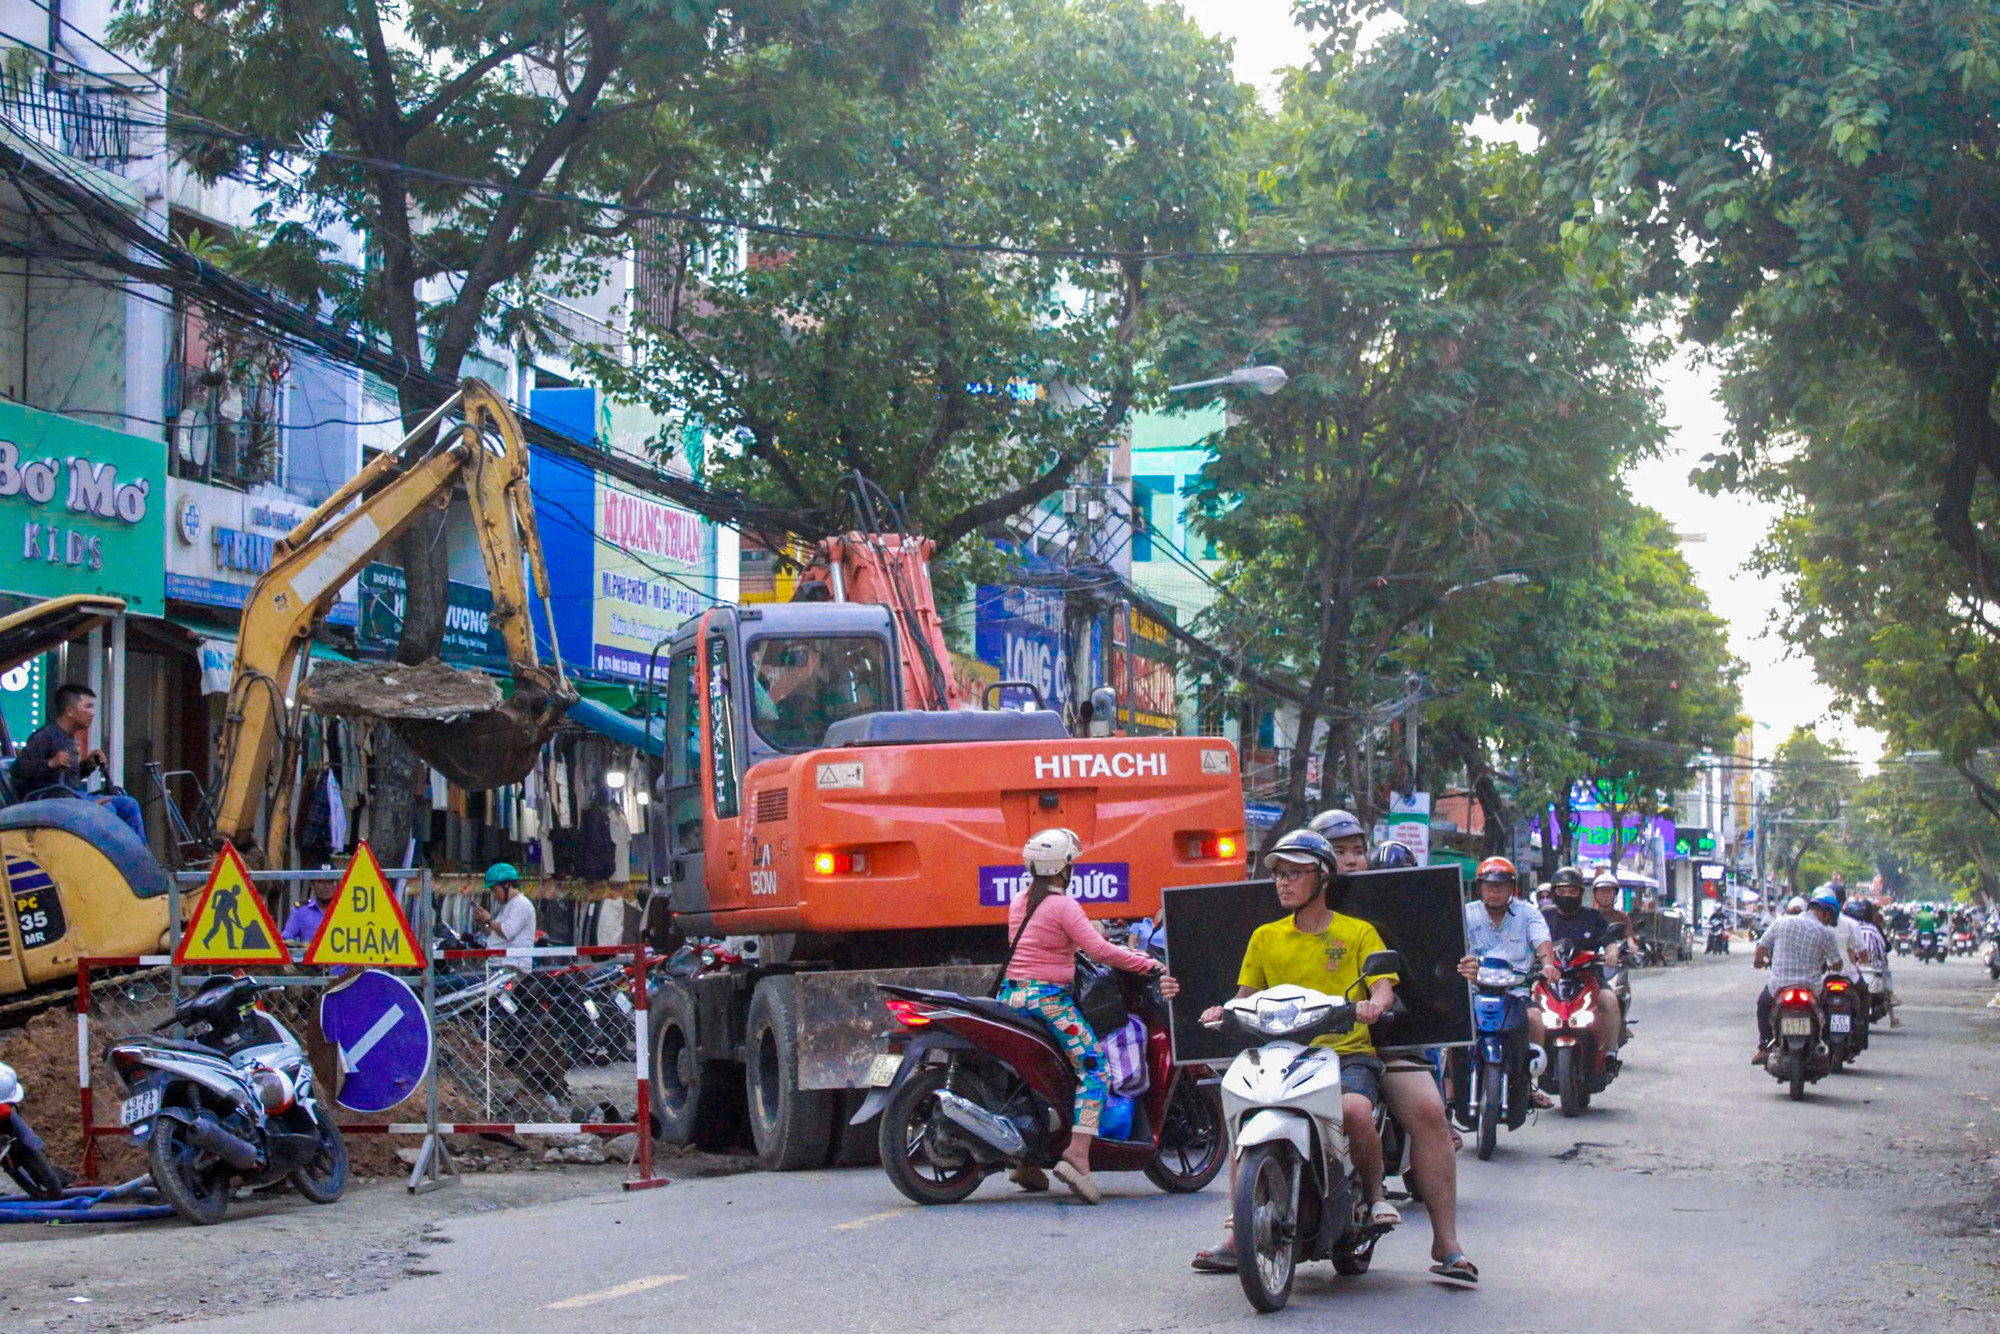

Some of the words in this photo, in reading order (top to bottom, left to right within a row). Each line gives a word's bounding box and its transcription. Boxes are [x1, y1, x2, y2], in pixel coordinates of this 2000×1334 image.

[0, 438, 60, 504] Bơ
[66, 456, 150, 525] Mơ
[24, 521, 103, 571] KIDS
[1034, 752, 1167, 779] HITACHI
[17, 896, 38, 911] PC
[352, 886, 375, 913] ĐI
[20, 911, 48, 931] 35
[24, 932, 46, 945] MR
[331, 920, 399, 961] CHẬM
